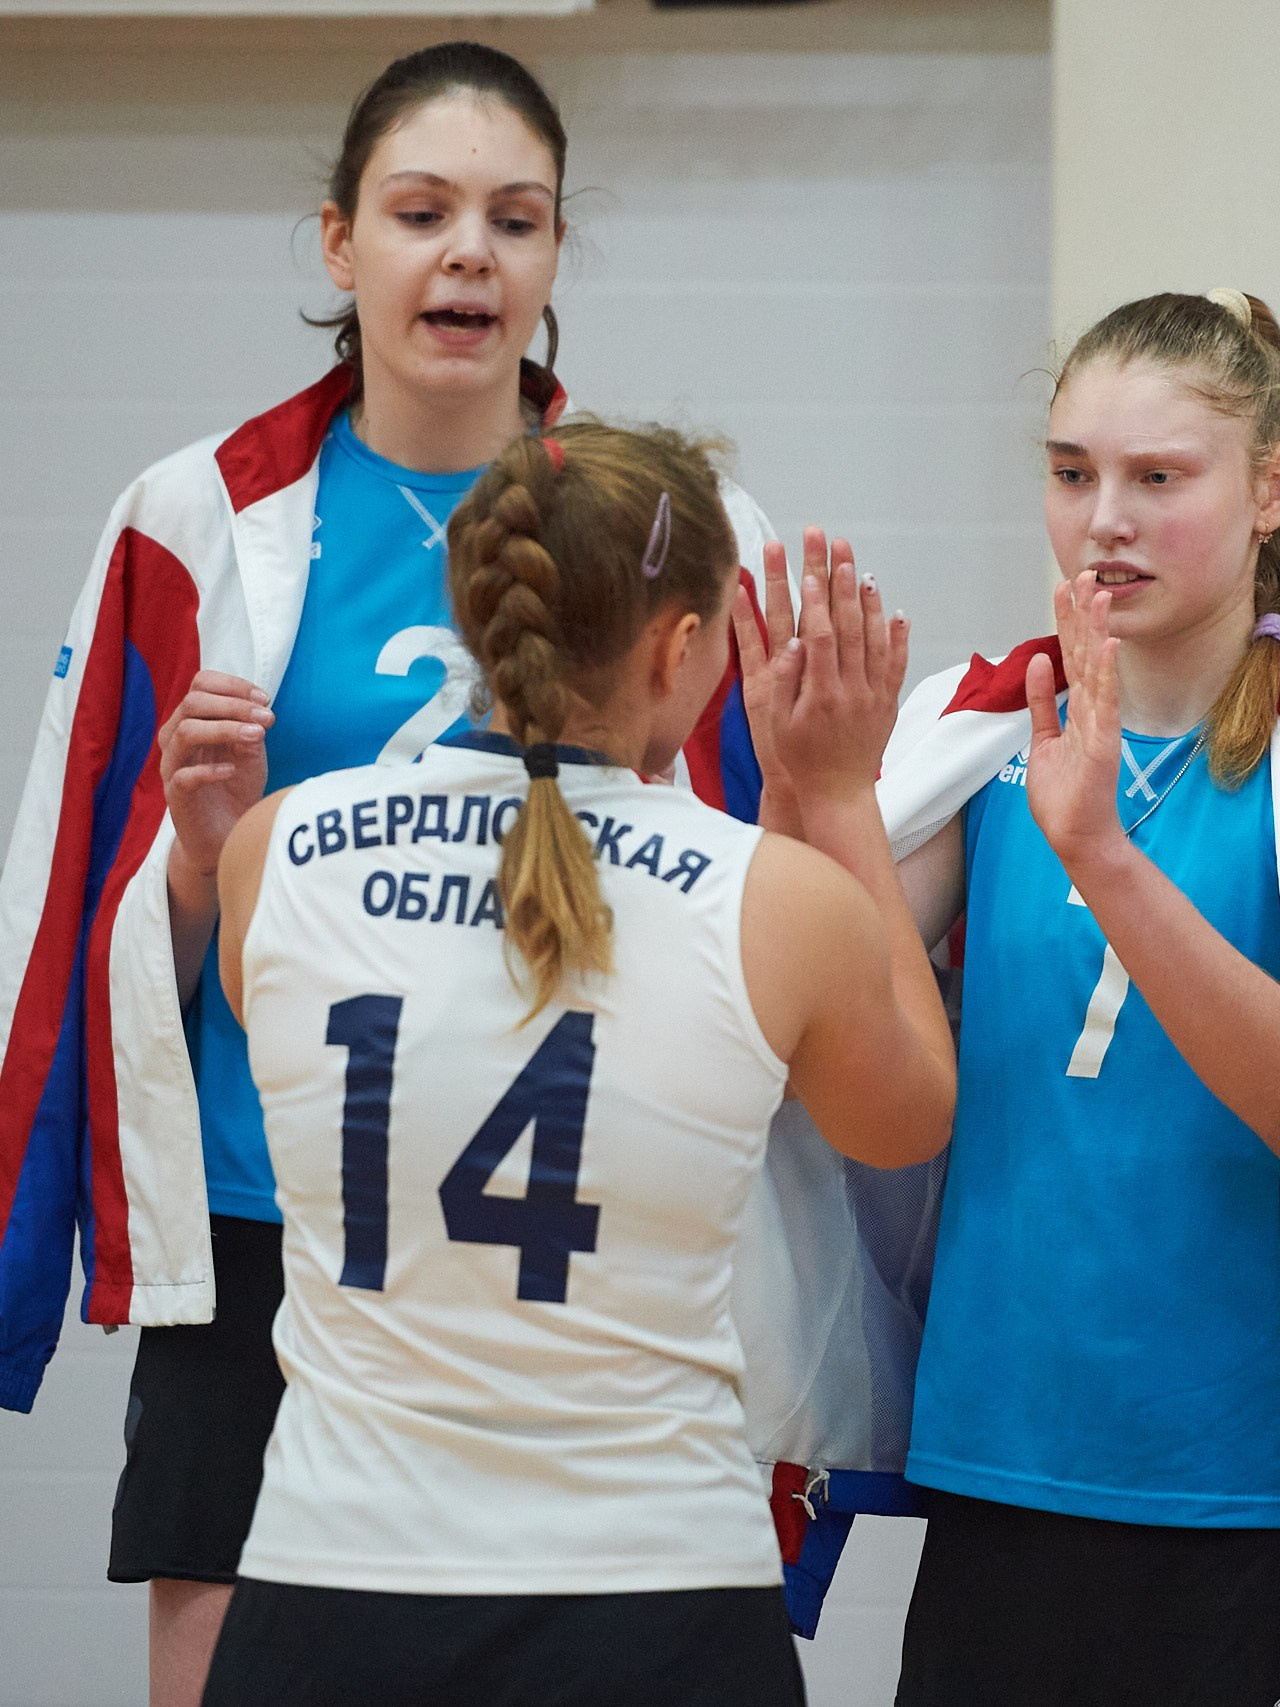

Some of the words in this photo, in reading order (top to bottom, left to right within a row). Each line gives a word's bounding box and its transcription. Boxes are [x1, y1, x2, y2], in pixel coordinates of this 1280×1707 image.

[374, 624, 482, 767] 2
[287, 793, 712, 895] СВЕРДЛОКАЯ
[325, 993, 602, 1303] 14
